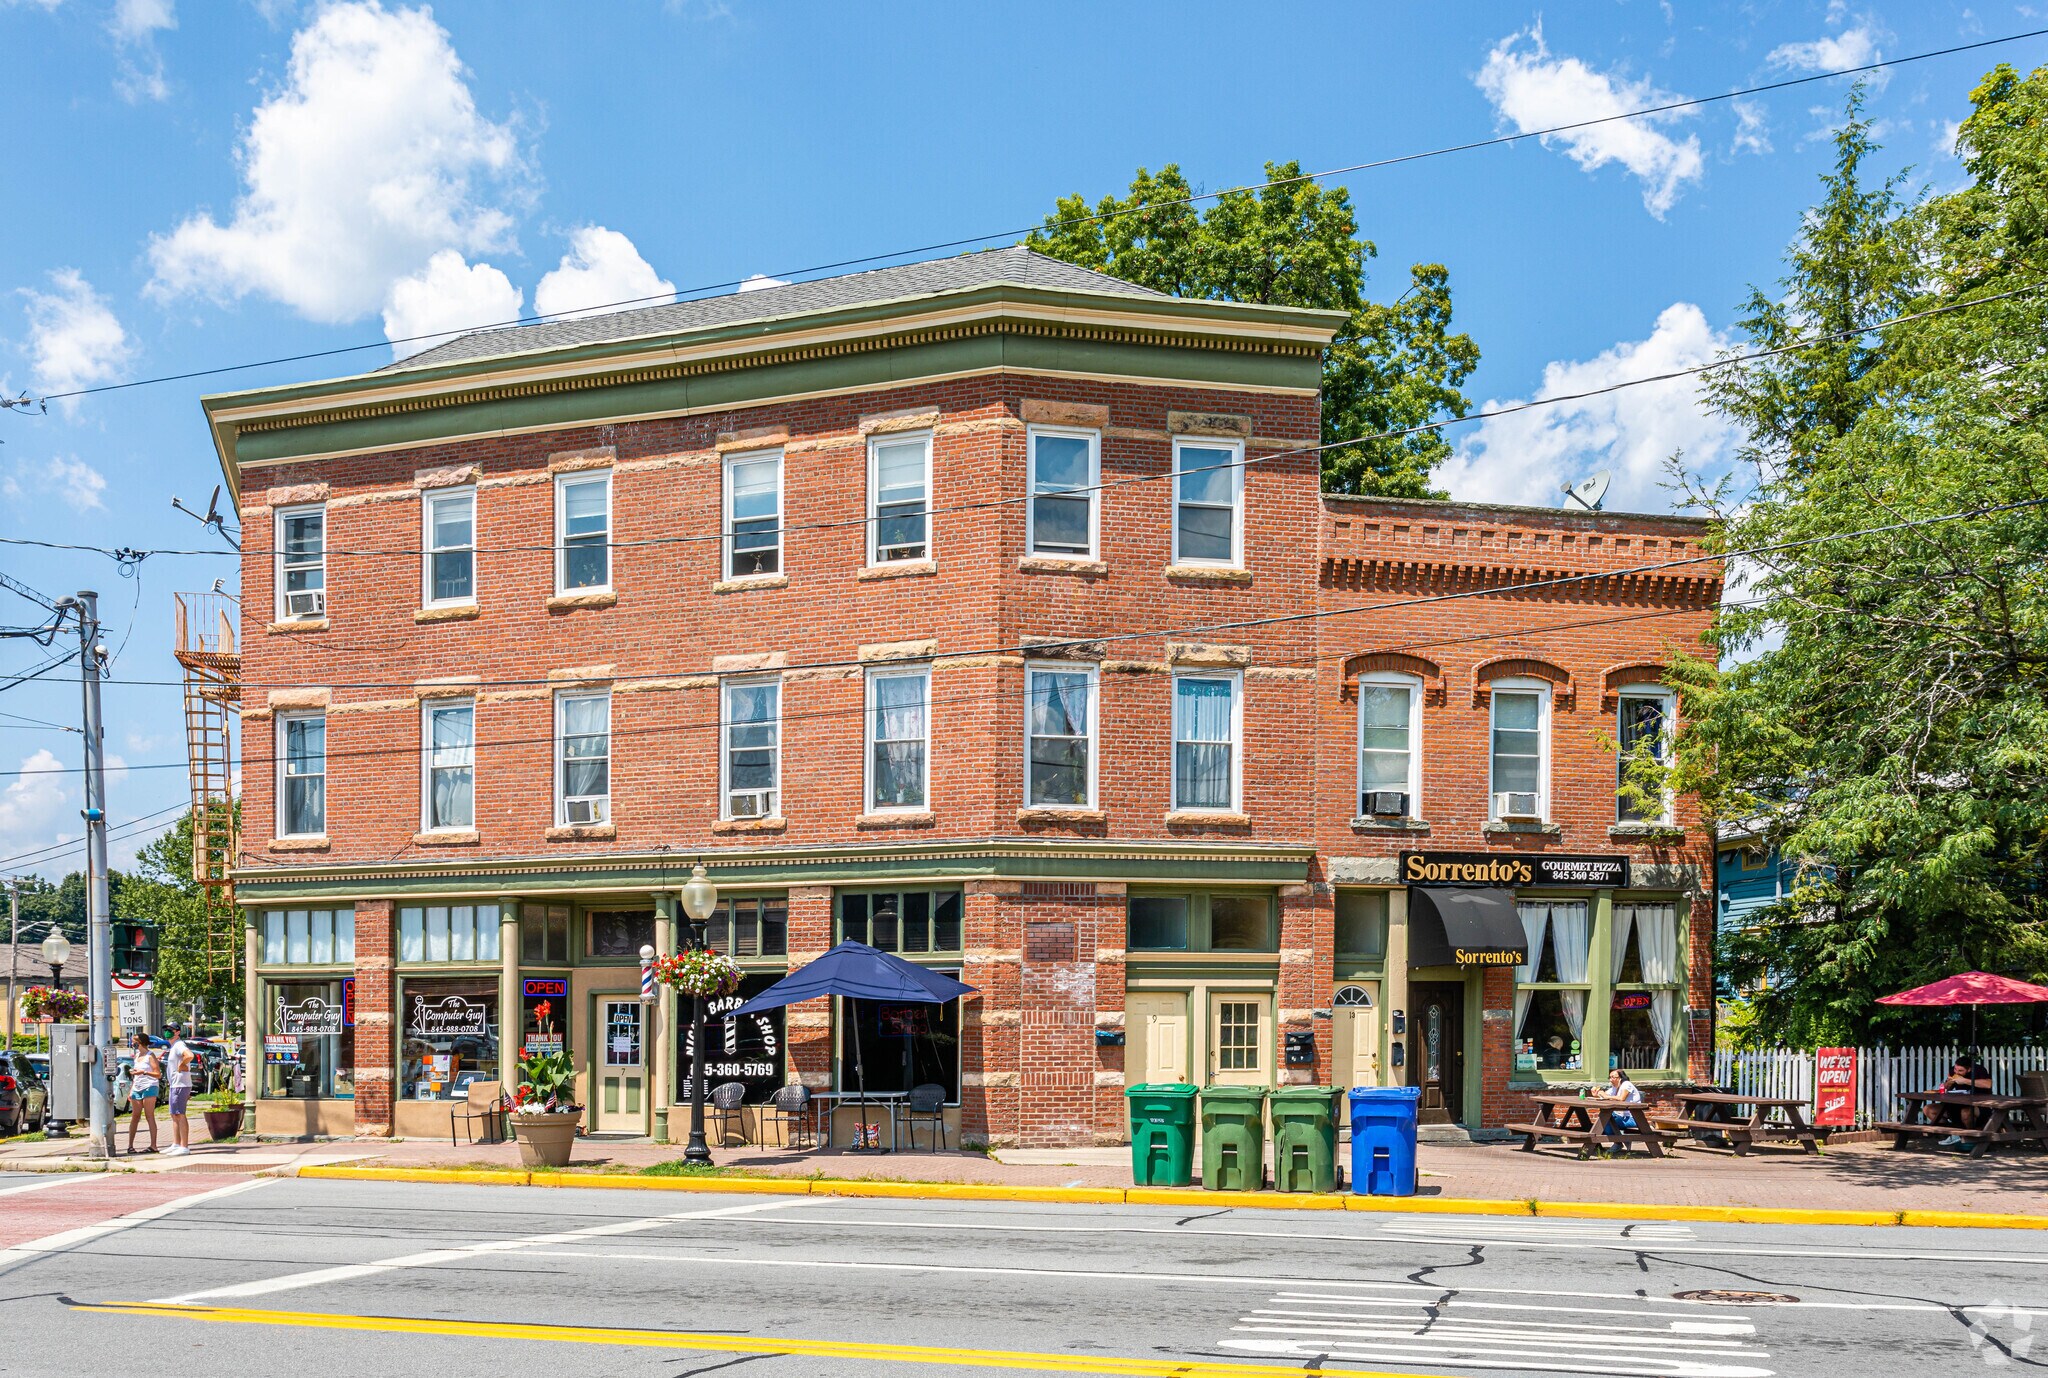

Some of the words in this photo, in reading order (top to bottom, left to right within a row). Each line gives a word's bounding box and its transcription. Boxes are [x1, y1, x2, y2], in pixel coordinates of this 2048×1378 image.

[1407, 855, 1532, 882] Sorrento's
[1541, 861, 1592, 872] GOURMET
[1593, 862, 1622, 872] PIZZA
[1552, 871, 1570, 880] 845
[1570, 871, 1587, 880] 360
[1455, 948, 1522, 964] Sorrento's
[525, 982, 564, 994] OPEN
[307, 1000, 319, 1009] The
[346, 981, 355, 1024] OPEN
[448, 998, 461, 1008] The
[1623, 997, 1650, 1007] OPEN
[123, 1016, 143, 1024] TONS
[286, 1010, 323, 1025] Computer
[324, 1010, 341, 1026] Guy
[425, 1009, 464, 1026] Computer
[465, 1009, 483, 1026] Guy
[614, 1014, 632, 1023] OPEN
[1152, 1014, 1158, 1023] 9
[1349, 1011, 1356, 1019] 13
[264, 1035, 284, 1043] THANK
[285, 1036, 297, 1044] YOU
[527, 1034, 549, 1042] THANK
[756, 1016, 776, 1056] SHOP
[1820, 1055, 1853, 1069] WE'RE
[621, 1068, 626, 1076] 7
[690, 1063, 775, 1076] 5-360-5769
[1820, 1069, 1853, 1084] OPEN!
